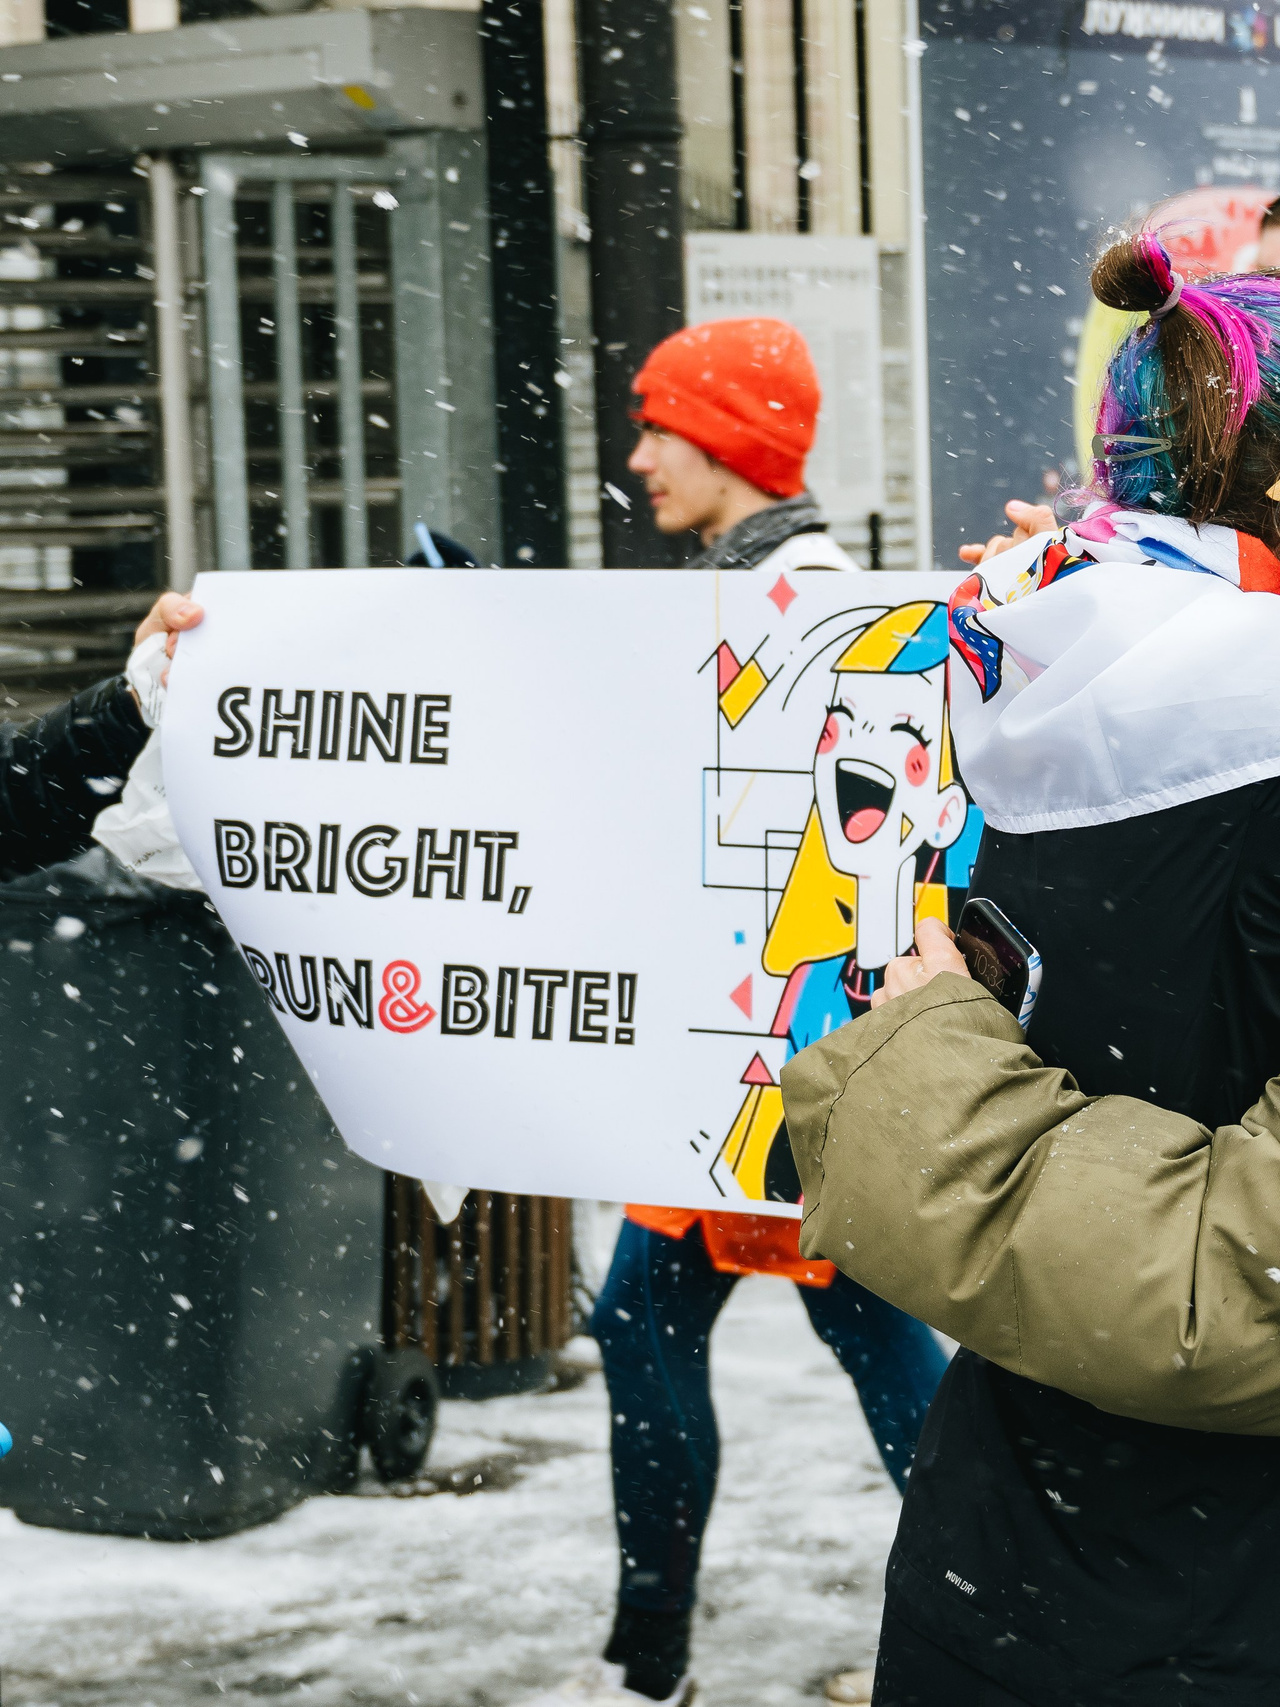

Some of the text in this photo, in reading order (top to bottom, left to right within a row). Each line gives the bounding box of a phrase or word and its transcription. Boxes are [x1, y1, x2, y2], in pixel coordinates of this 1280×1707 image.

[213, 686, 452, 765] SHINE
[213, 818, 533, 914] BRIGHT,
[973, 948, 1007, 996] 10:34
